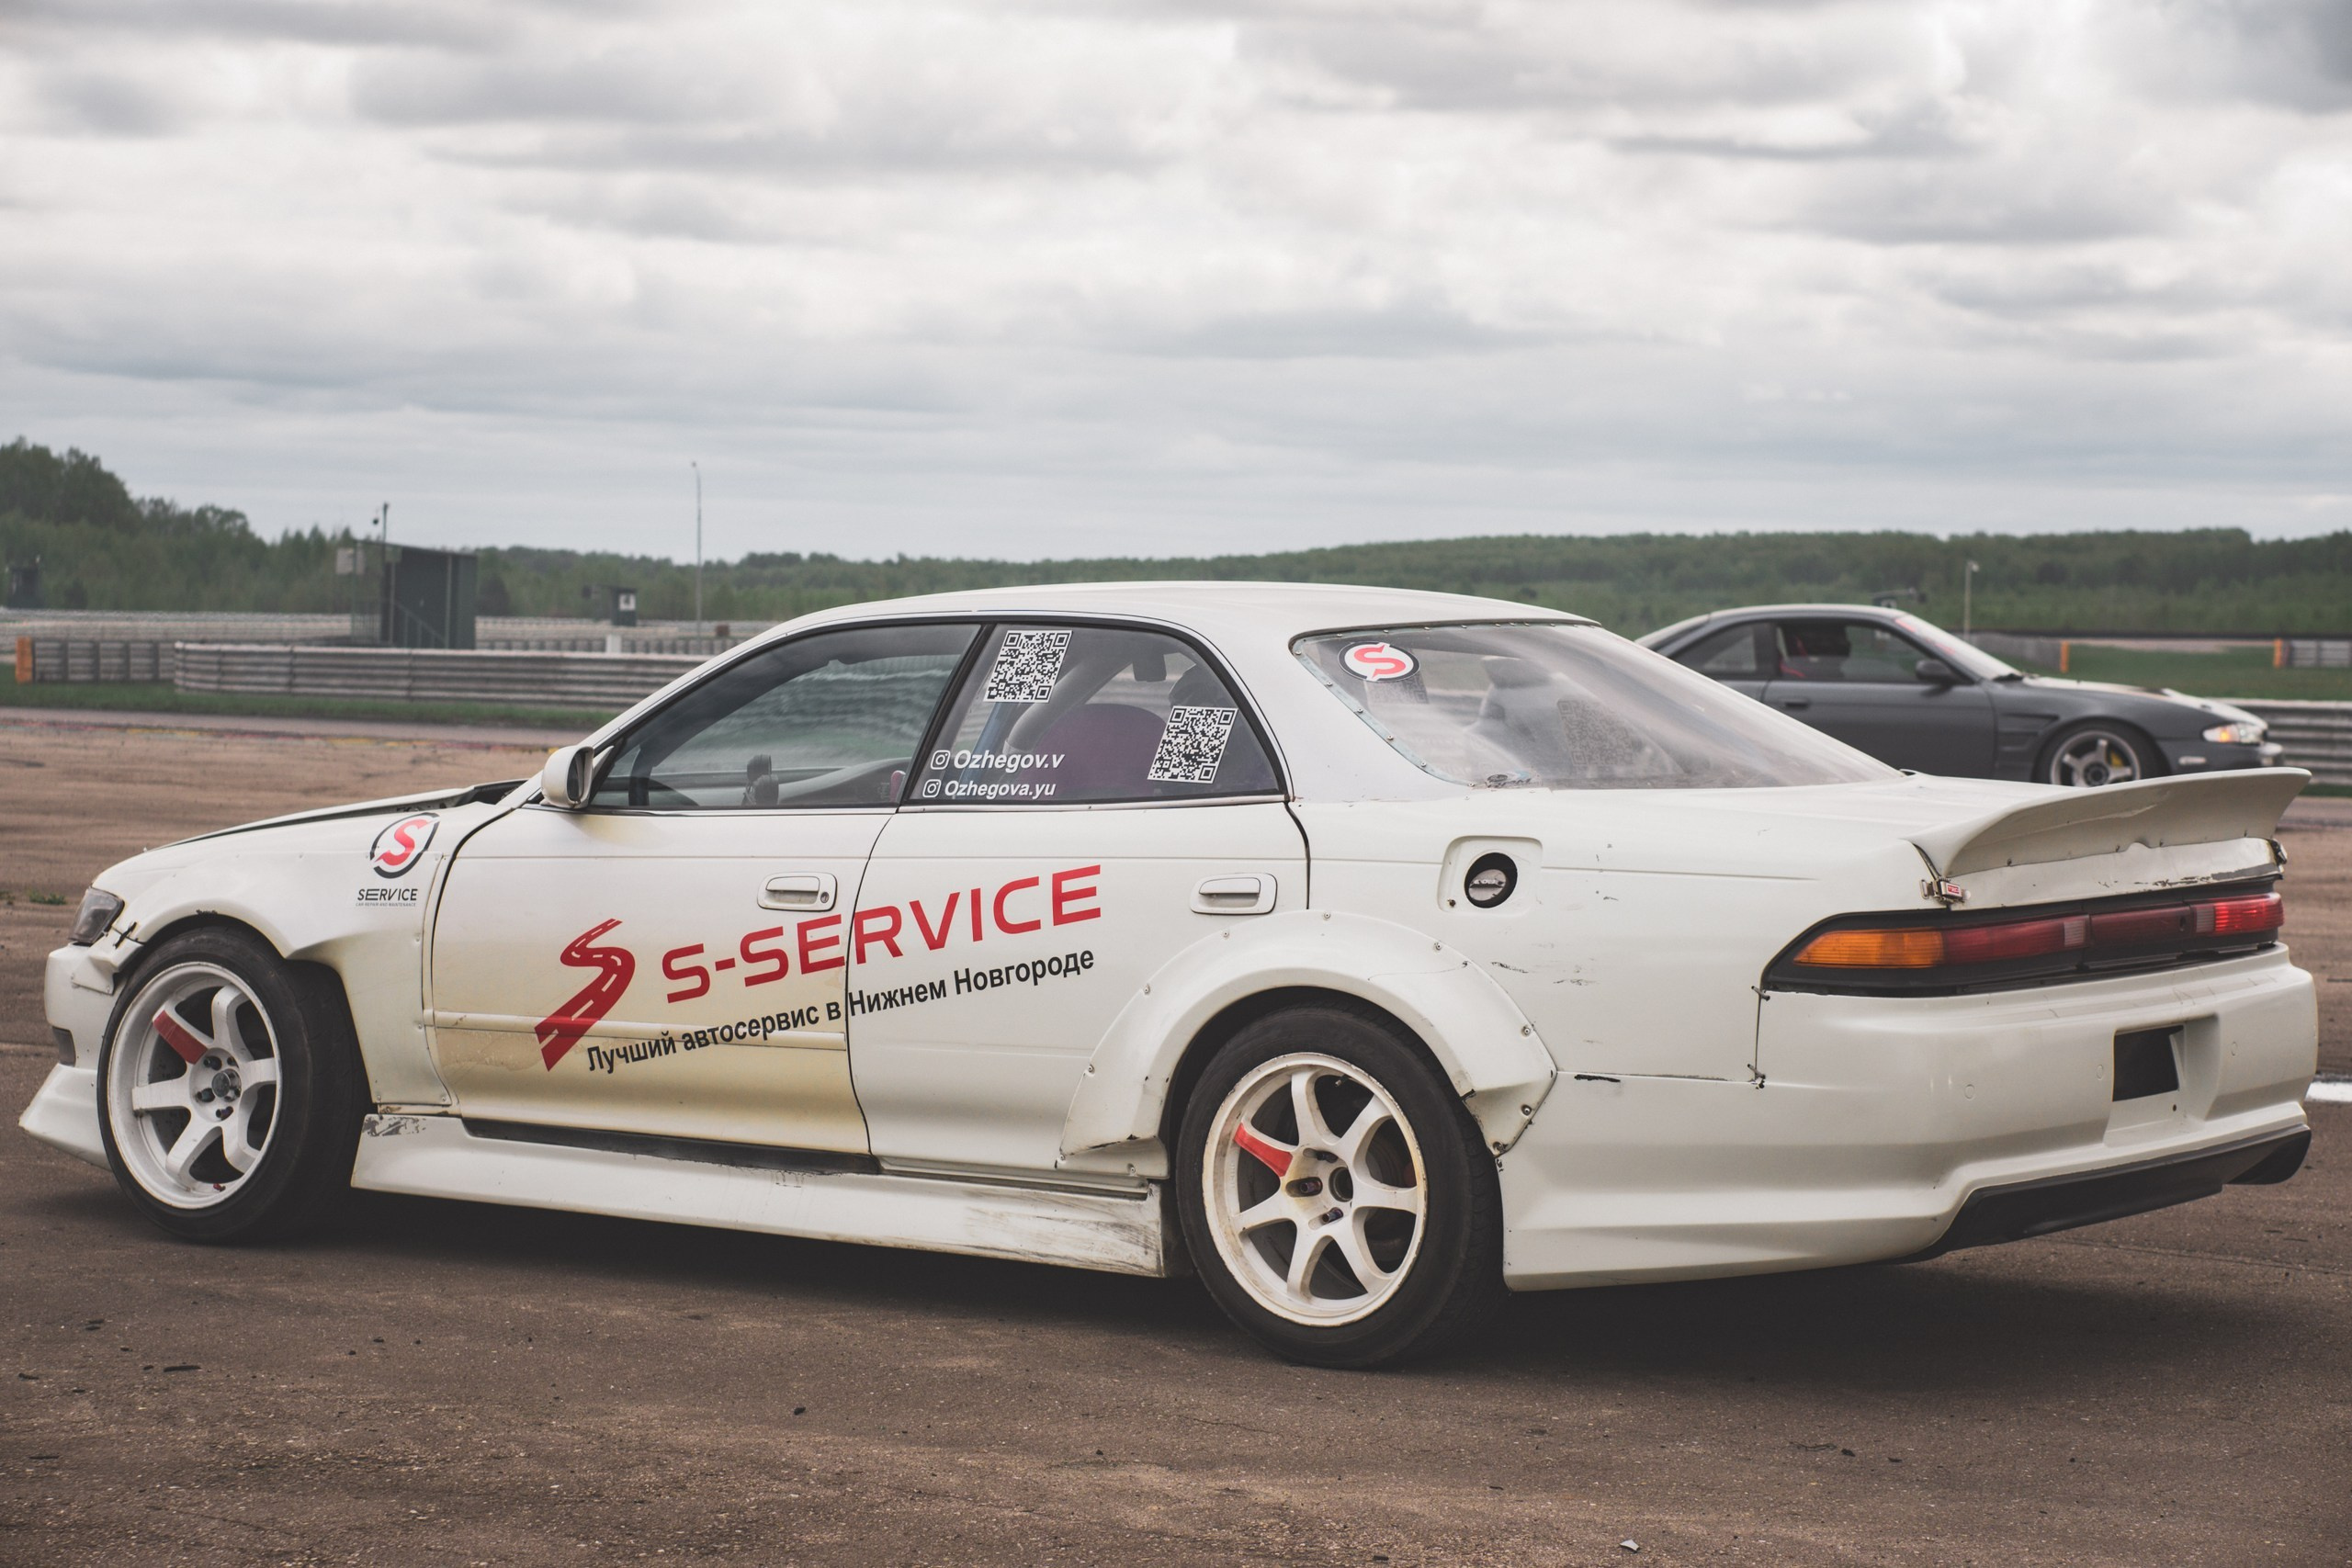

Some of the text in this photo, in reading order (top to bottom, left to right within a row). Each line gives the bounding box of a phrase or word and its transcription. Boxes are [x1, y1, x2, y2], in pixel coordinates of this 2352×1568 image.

[954, 749, 1066, 774] Ozhegov.v
[944, 779, 1057, 800] Ozhegova.yu
[356, 888, 418, 901] SERVICE
[662, 865, 1102, 1004] S-SERVICE
[588, 950, 1094, 1075] Лучший автосервис в Нижнем Новгороде
